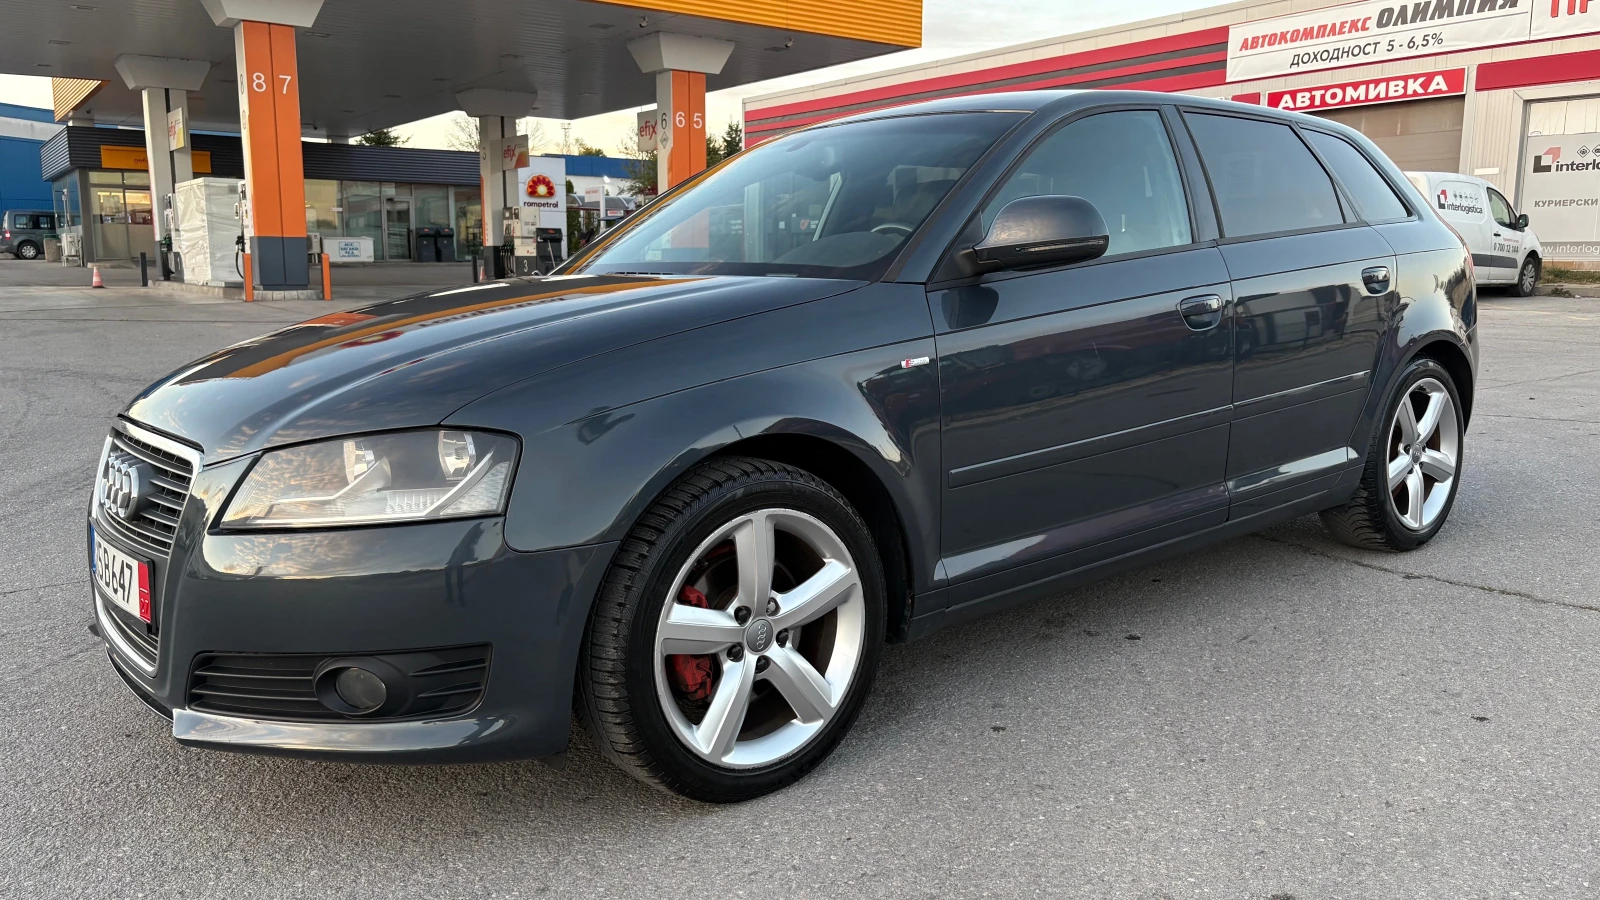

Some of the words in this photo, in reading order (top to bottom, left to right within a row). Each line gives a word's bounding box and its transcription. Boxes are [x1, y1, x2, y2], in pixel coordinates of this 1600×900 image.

[1239, 16, 1372, 52] АВТОКОМПЛЕКС
[1289, 41, 1381, 69] ДОХОДНОСТ
[1386, 39, 1395, 53] 5
[1407, 31, 1444, 51] 6,5%
[252, 72, 267, 92] 8
[278, 74, 292, 95] 7
[1277, 74, 1448, 109] АВТОМИВКА
[661, 112, 667, 130] 6
[675, 111, 686, 128] 6
[693, 112, 703, 129] 5
[639, 119, 658, 141] efix
[503, 143, 517, 161] efix
[523, 201, 559, 209] rompetrol
[1446, 201, 1483, 215] interlogistica
[1534, 198, 1599, 208] КУРИЕРСКИ
[523, 259, 529, 273] 3
